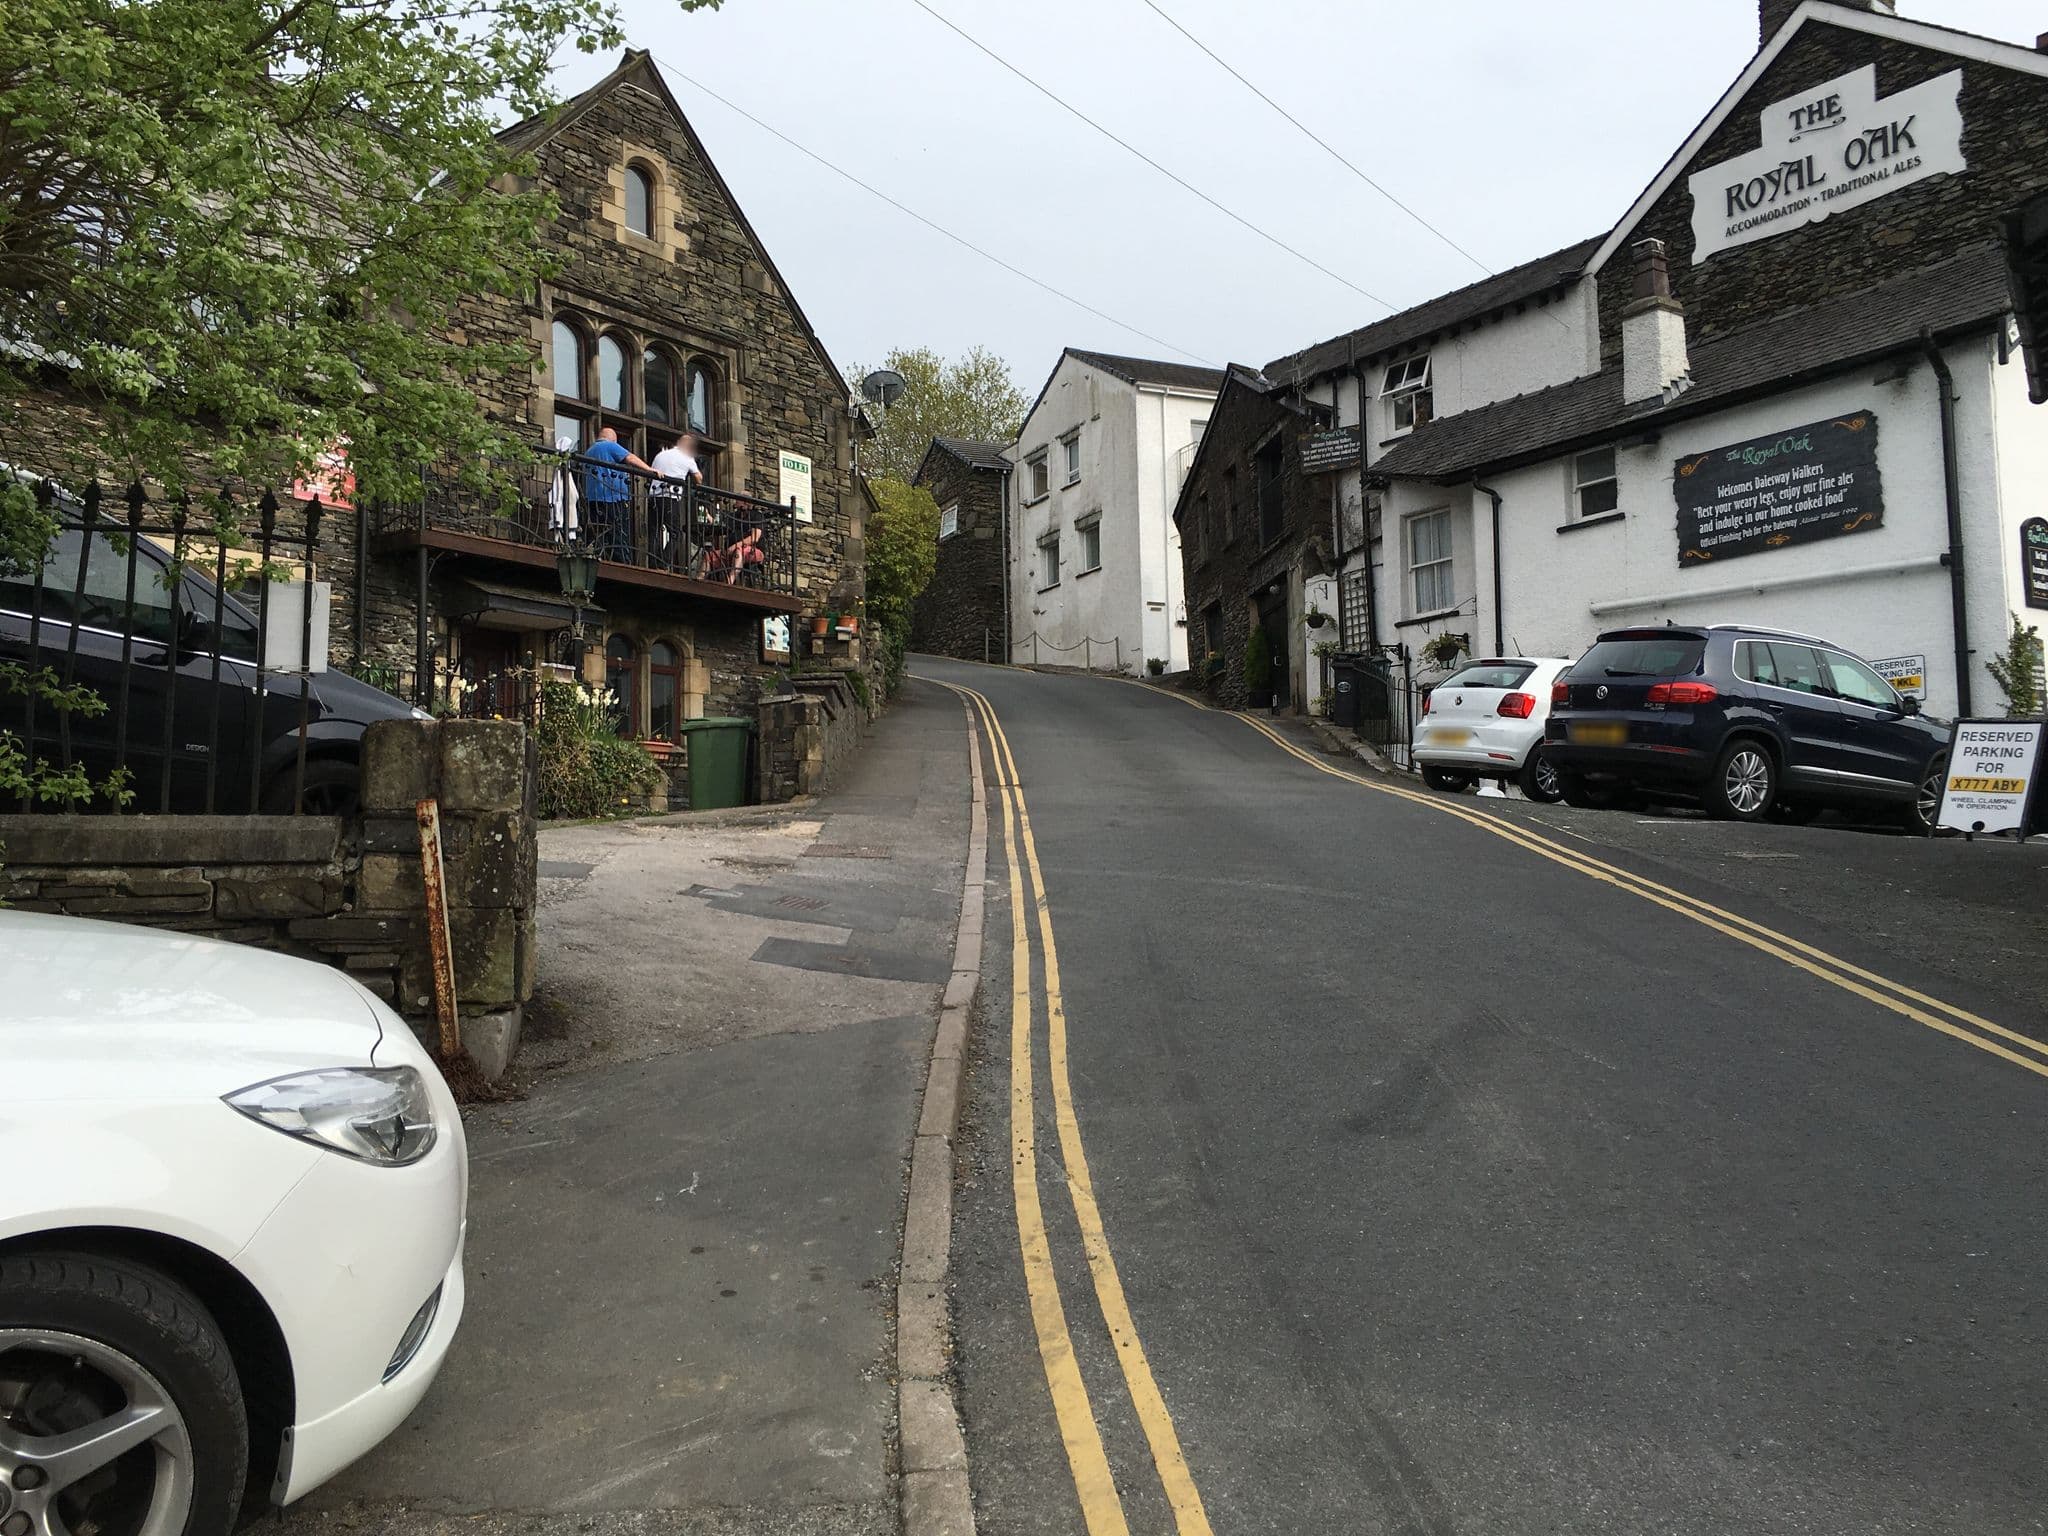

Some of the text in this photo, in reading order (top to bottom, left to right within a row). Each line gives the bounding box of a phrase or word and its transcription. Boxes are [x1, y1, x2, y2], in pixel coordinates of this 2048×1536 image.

[1789, 93, 1843, 130] THE
[1725, 115, 1917, 217] ROYAL OAK
[1725, 155, 1921, 237] ACCOMMODATION TRADITIONAL ALES
[1743, 441, 1782, 465] Royal
[1782, 433, 1813, 453] Oak
[783, 459, 808, 472] TO LET
[1717, 463, 1823, 498] Welcomes Dalesway Walkers
[1714, 502, 1732, 517] your
[1734, 495, 1758, 510] weary
[1759, 491, 1777, 505] legs,
[1779, 485, 1801, 500] enjoy
[1803, 481, 1818, 494] our
[1819, 477, 1835, 491] fine
[1837, 471, 1854, 485] ales
[1699, 520, 1713, 534] and
[1715, 515, 1743, 531] indulge
[1744, 511, 1753, 523] in
[1754, 508, 1768, 521] our
[1770, 503, 1792, 518] home
[1794, 496, 1823, 511] cooked
[1874, 659, 1916, 671] RESERVED
[1906, 667, 1922, 675] FOR
[1960, 731, 2034, 743] RESERVED
[1963, 746, 2025, 758] PARKING
[1975, 761, 2004, 773] FOR
[1953, 778, 2020, 791] X777 ABY
[1950, 796, 2016, 805] WHEEL CLAMPING
